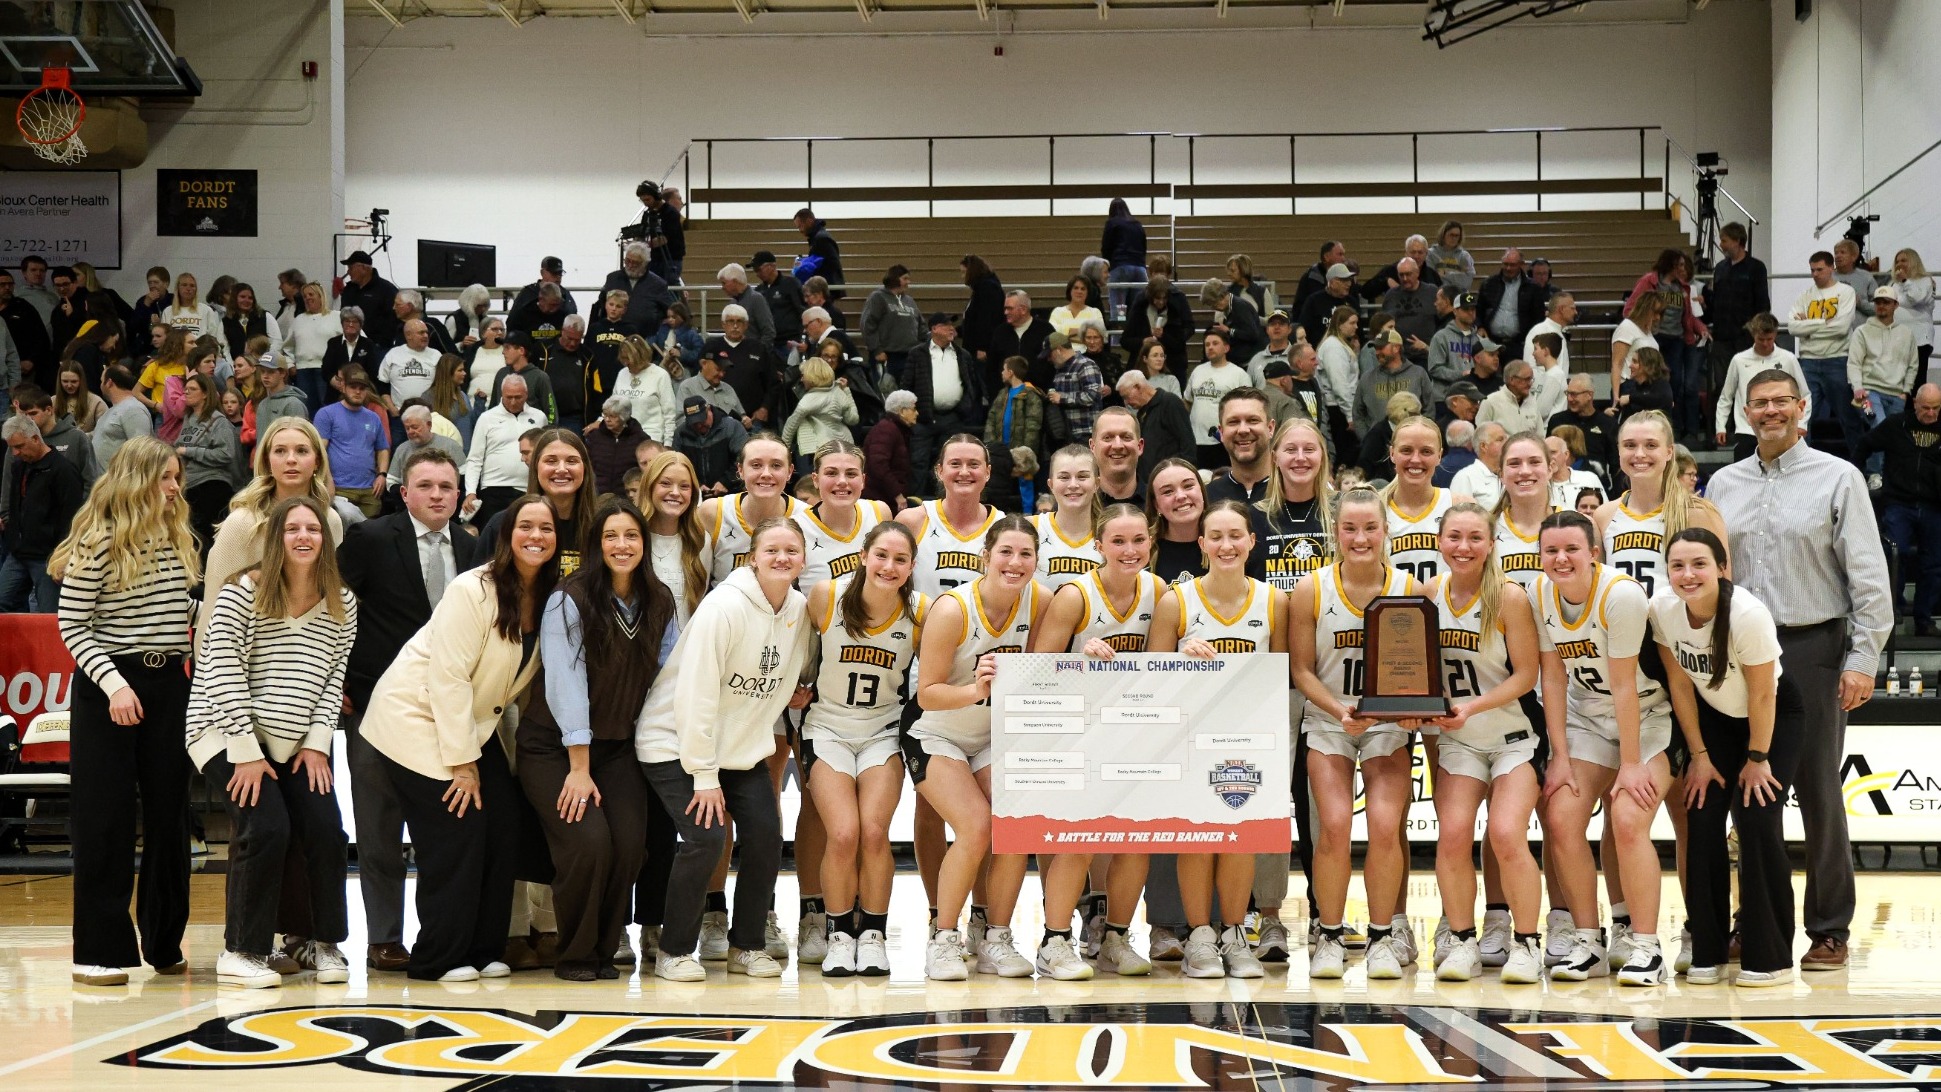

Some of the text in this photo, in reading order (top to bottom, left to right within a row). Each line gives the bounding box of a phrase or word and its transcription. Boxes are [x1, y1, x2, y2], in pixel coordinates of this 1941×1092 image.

[179, 181, 235, 193] DORDT
[28, 195, 69, 206] Center
[71, 194, 109, 206] Health
[187, 197, 228, 209] FANS
[8, 208, 35, 216] Avera
[36, 208, 71, 217] Partner
[1807, 297, 1839, 320] NS
[1268, 544, 1279, 555] 20
[1391, 534, 1439, 555] DORDT
[1613, 532, 1662, 553] DORDT
[830, 553, 861, 577] DOR
[1049, 557, 1100, 576] DORDT
[1501, 553, 1543, 573] DORD
[1209, 639, 1254, 653] ORDT
[1334, 629, 1365, 649] DOR
[1440, 630, 1480, 651] ORDT
[841, 646, 896, 669] DORDT
[1055, 660, 1225, 672] NAIA NATIONAL CHAMPIONSHIP
[728, 672, 783, 693] DORDT
[1445, 659, 1481, 697] 21
[1574, 666, 1612, 696] 12
[732, 690, 773, 700] UNIVERSITY
[847, 672, 880, 707] 13
[1210, 771, 1260, 783] BASKETBALL
[1056, 832, 1224, 843] BATTLE FOR THE RED BANNER
